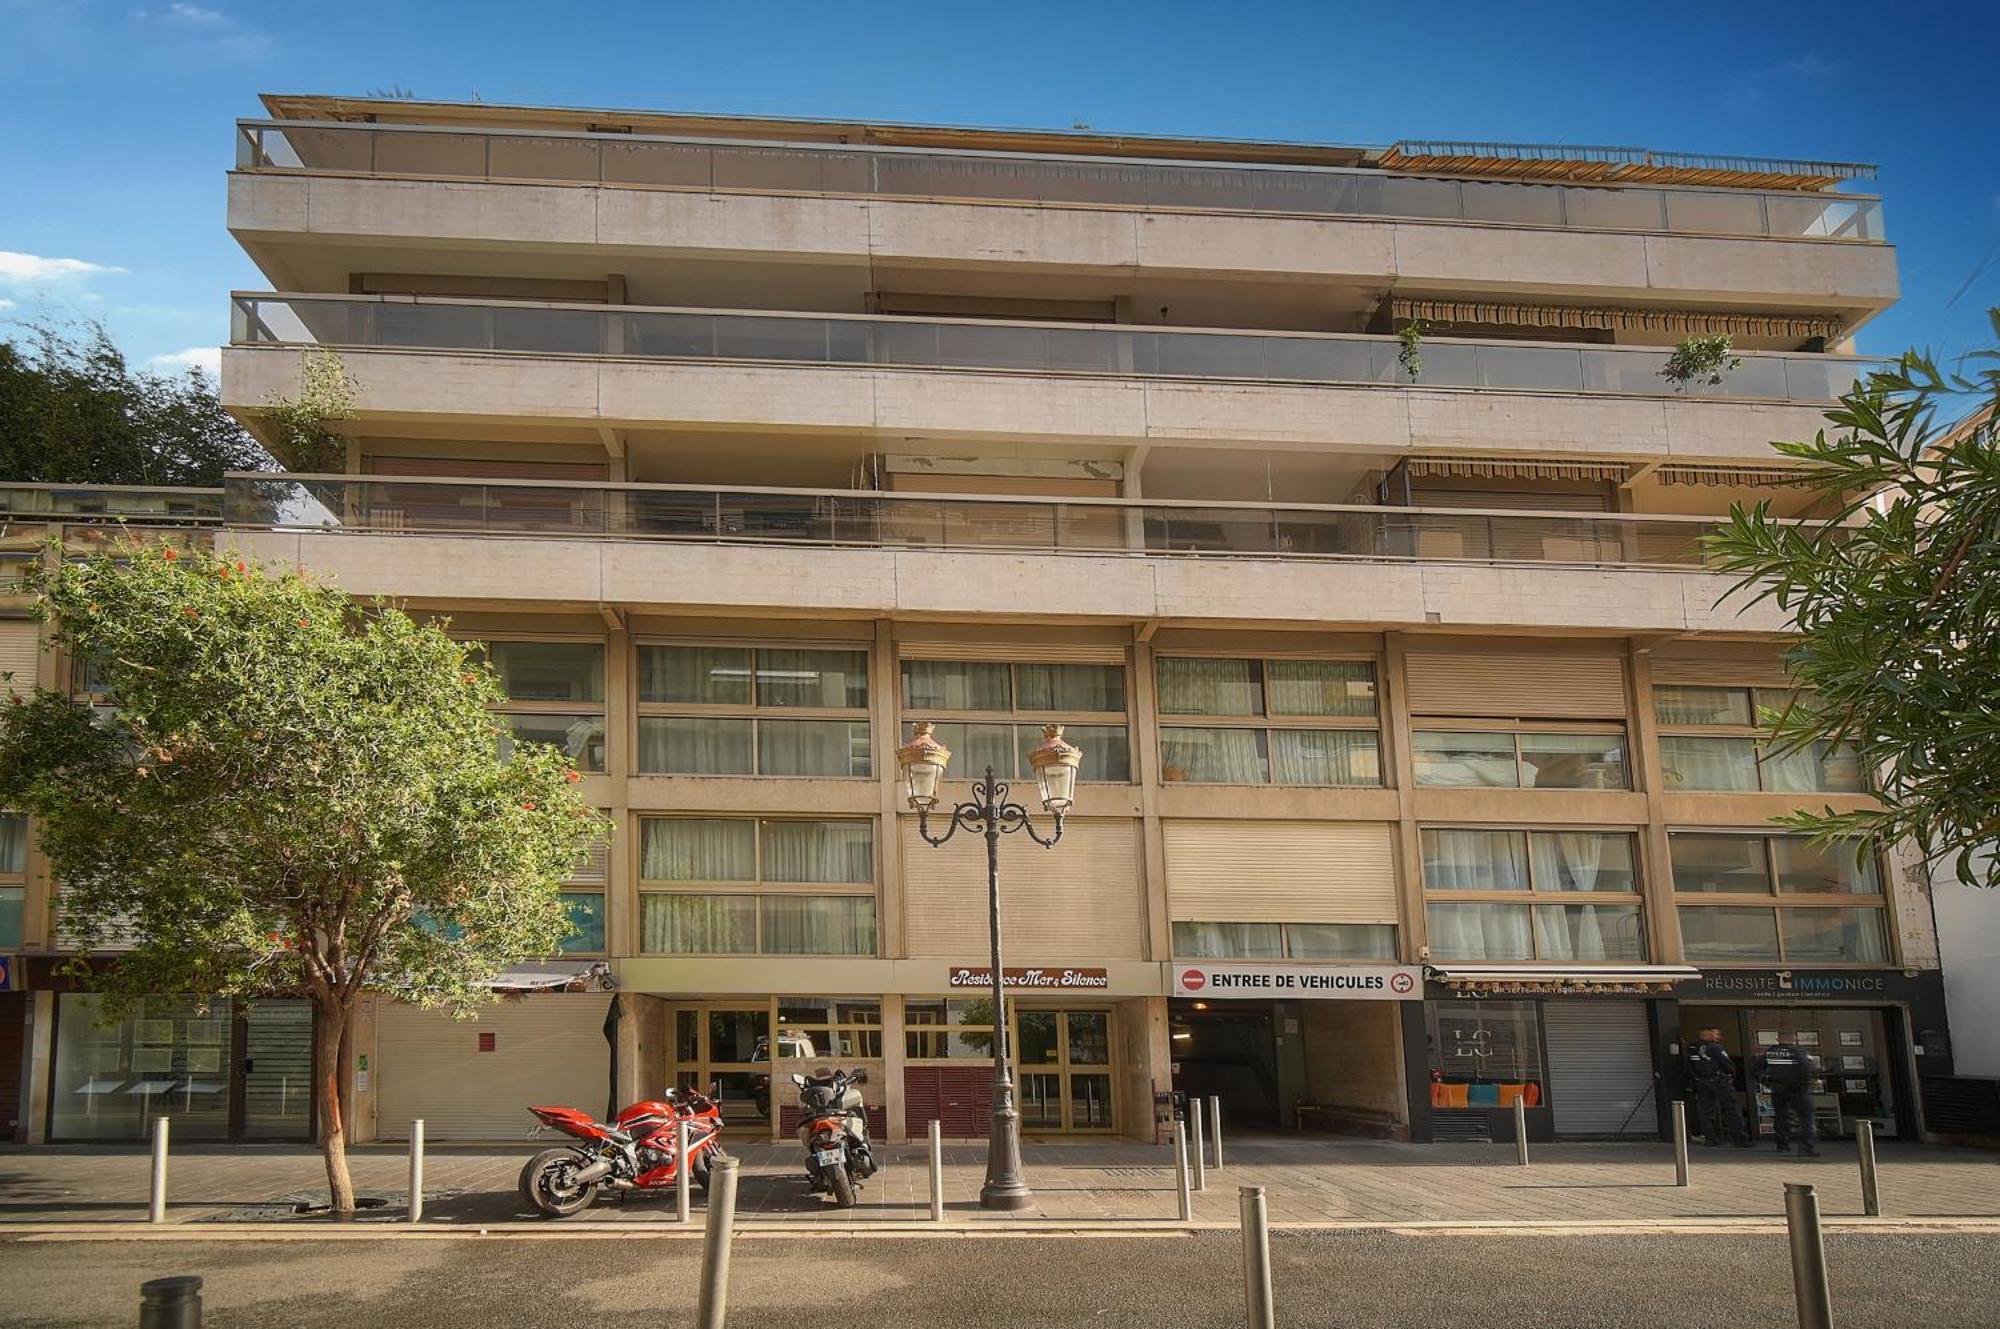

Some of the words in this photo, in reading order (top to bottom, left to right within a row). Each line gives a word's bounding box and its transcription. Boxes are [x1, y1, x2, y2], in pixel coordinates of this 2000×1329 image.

[951, 970, 1017, 986] Résidce
[1018, 970, 1055, 986] Mer
[1061, 970, 1108, 986] Silence
[1212, 973, 1271, 988] ENTREE
[1275, 974, 1295, 988] DE
[1299, 975, 1384, 989] VEHICULES
[1706, 976, 1775, 990] RÉUSSITE
[1794, 977, 1884, 991] IMMONICE
